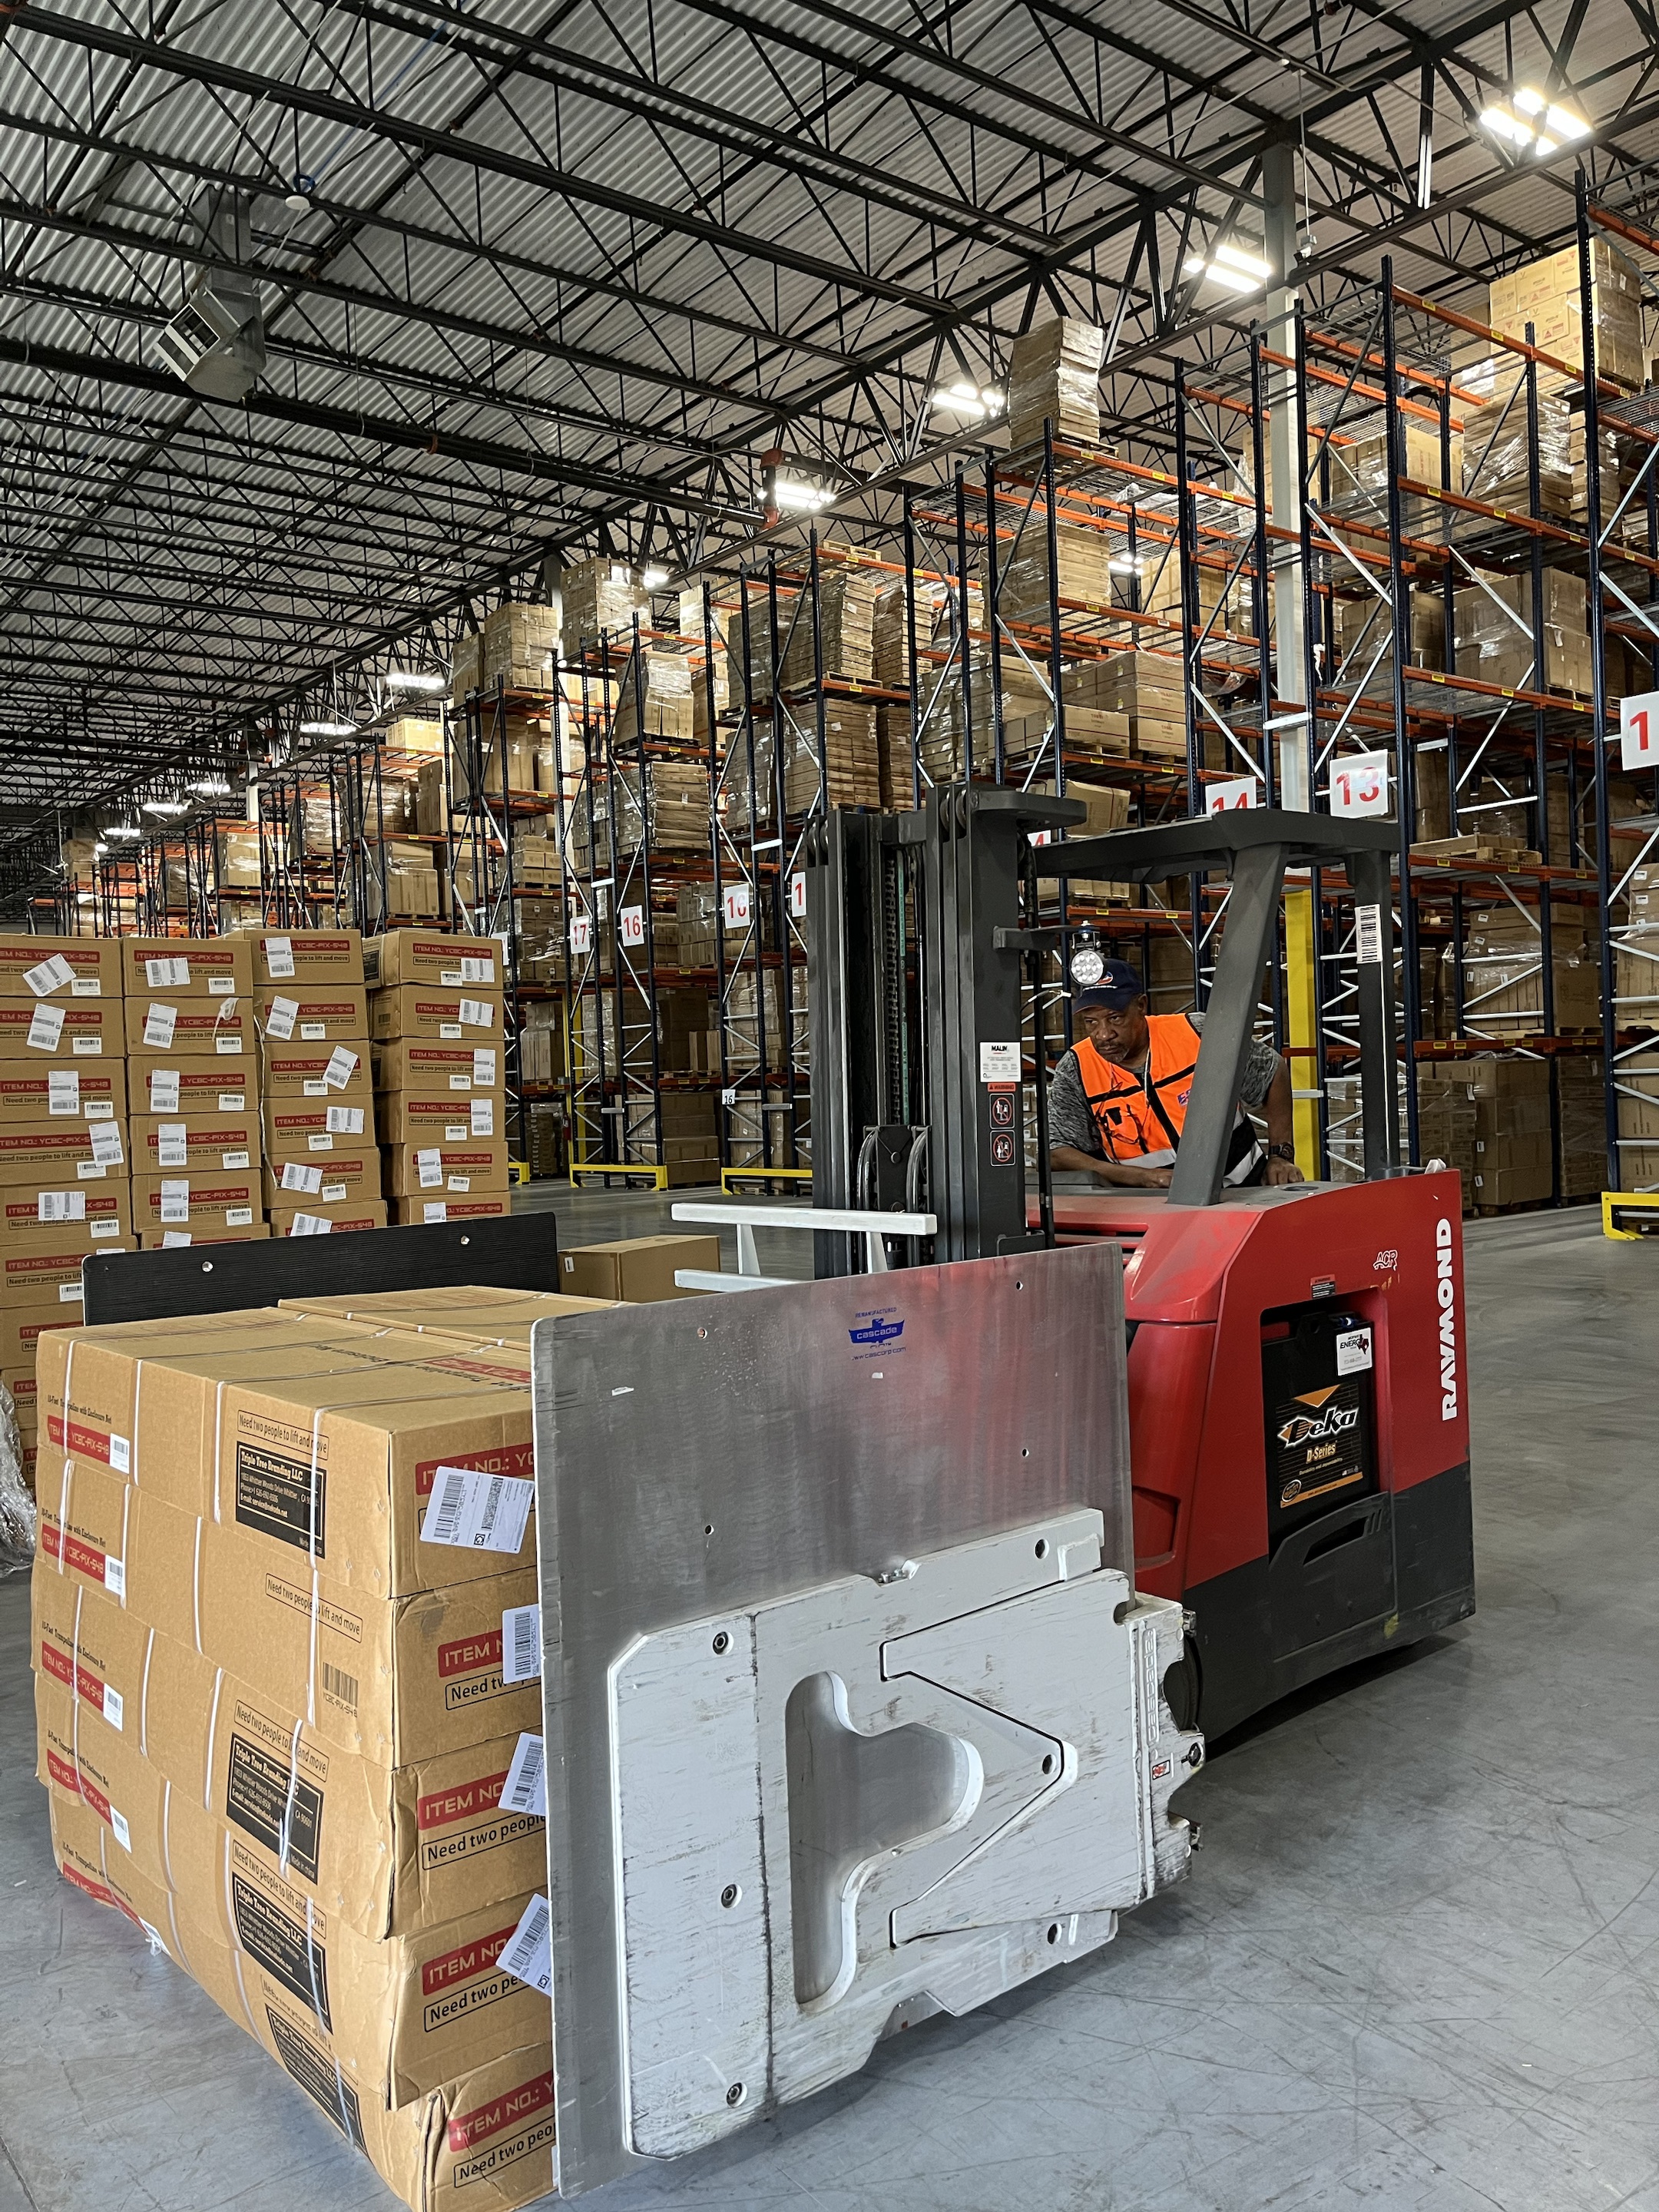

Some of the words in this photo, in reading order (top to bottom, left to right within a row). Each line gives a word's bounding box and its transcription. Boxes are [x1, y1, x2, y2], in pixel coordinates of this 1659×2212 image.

[1336, 766, 1380, 806] 13
[572, 924, 587, 945] 17
[624, 914, 641, 938] 16
[724, 1094, 733, 1104] 16
[856, 1326, 897, 1339] cascade
[1436, 1218, 1457, 1421] RAYMOND
[239, 1414, 253, 1429] Need
[253, 1420, 263, 1432] two
[263, 1426, 283, 1440] people
[283, 1430, 290, 1440] to
[290, 1429, 299, 1442] lift
[299, 1435, 310, 1448] and
[1286, 1407, 1357, 1447] Deka
[240, 1450, 256, 1466] Triple
[256, 1455, 269, 1469] Tree
[291, 1468, 303, 1482] LLC
[1306, 1442, 1337, 1464] D-Series
[267, 1579, 282, 1595] Need
[283, 1588, 293, 1601] two
[294, 1593, 313, 1613] people
[321, 1604, 330, 1620] lift
[331, 1611, 343, 1626] and
[343, 1619, 360, 1635] move
[445, 1641, 490, 1667] ITEM
[452, 1677, 488, 1702] Need
[237, 1704, 251, 1723] Need
[251, 1714, 261, 1731] two
[262, 1722, 282, 1745] people
[282, 1733, 289, 1748] to
[297, 1745, 310, 1762] and
[310, 1755, 326, 1774] move
[235, 1743, 252, 1764] Triple
[251, 1752, 263, 1772] Tree
[426, 1791, 472, 1820] ITEM
[428, 1836, 466, 1862] Need
[471, 1830, 497, 1847] two
[234, 1843, 249, 1866] Need
[249, 1856, 260, 1876] two
[260, 1867, 279, 1891] people
[279, 1883, 286, 1899] to
[286, 1887, 294, 1906] lift
[237, 1883, 254, 1908] Triple
[290, 1928, 303, 1947] LLC
[429, 1952, 475, 1985] ITEM
[430, 1992, 468, 2023] Need
[471, 1983, 498, 2003] two
[455, 2107, 501, 2141] ITEM
[505, 2088, 540, 2117] NO.:
[460, 2151, 496, 2180] Need
[499, 2140, 525, 2161] two
[528, 2124, 553, 2150] peo
